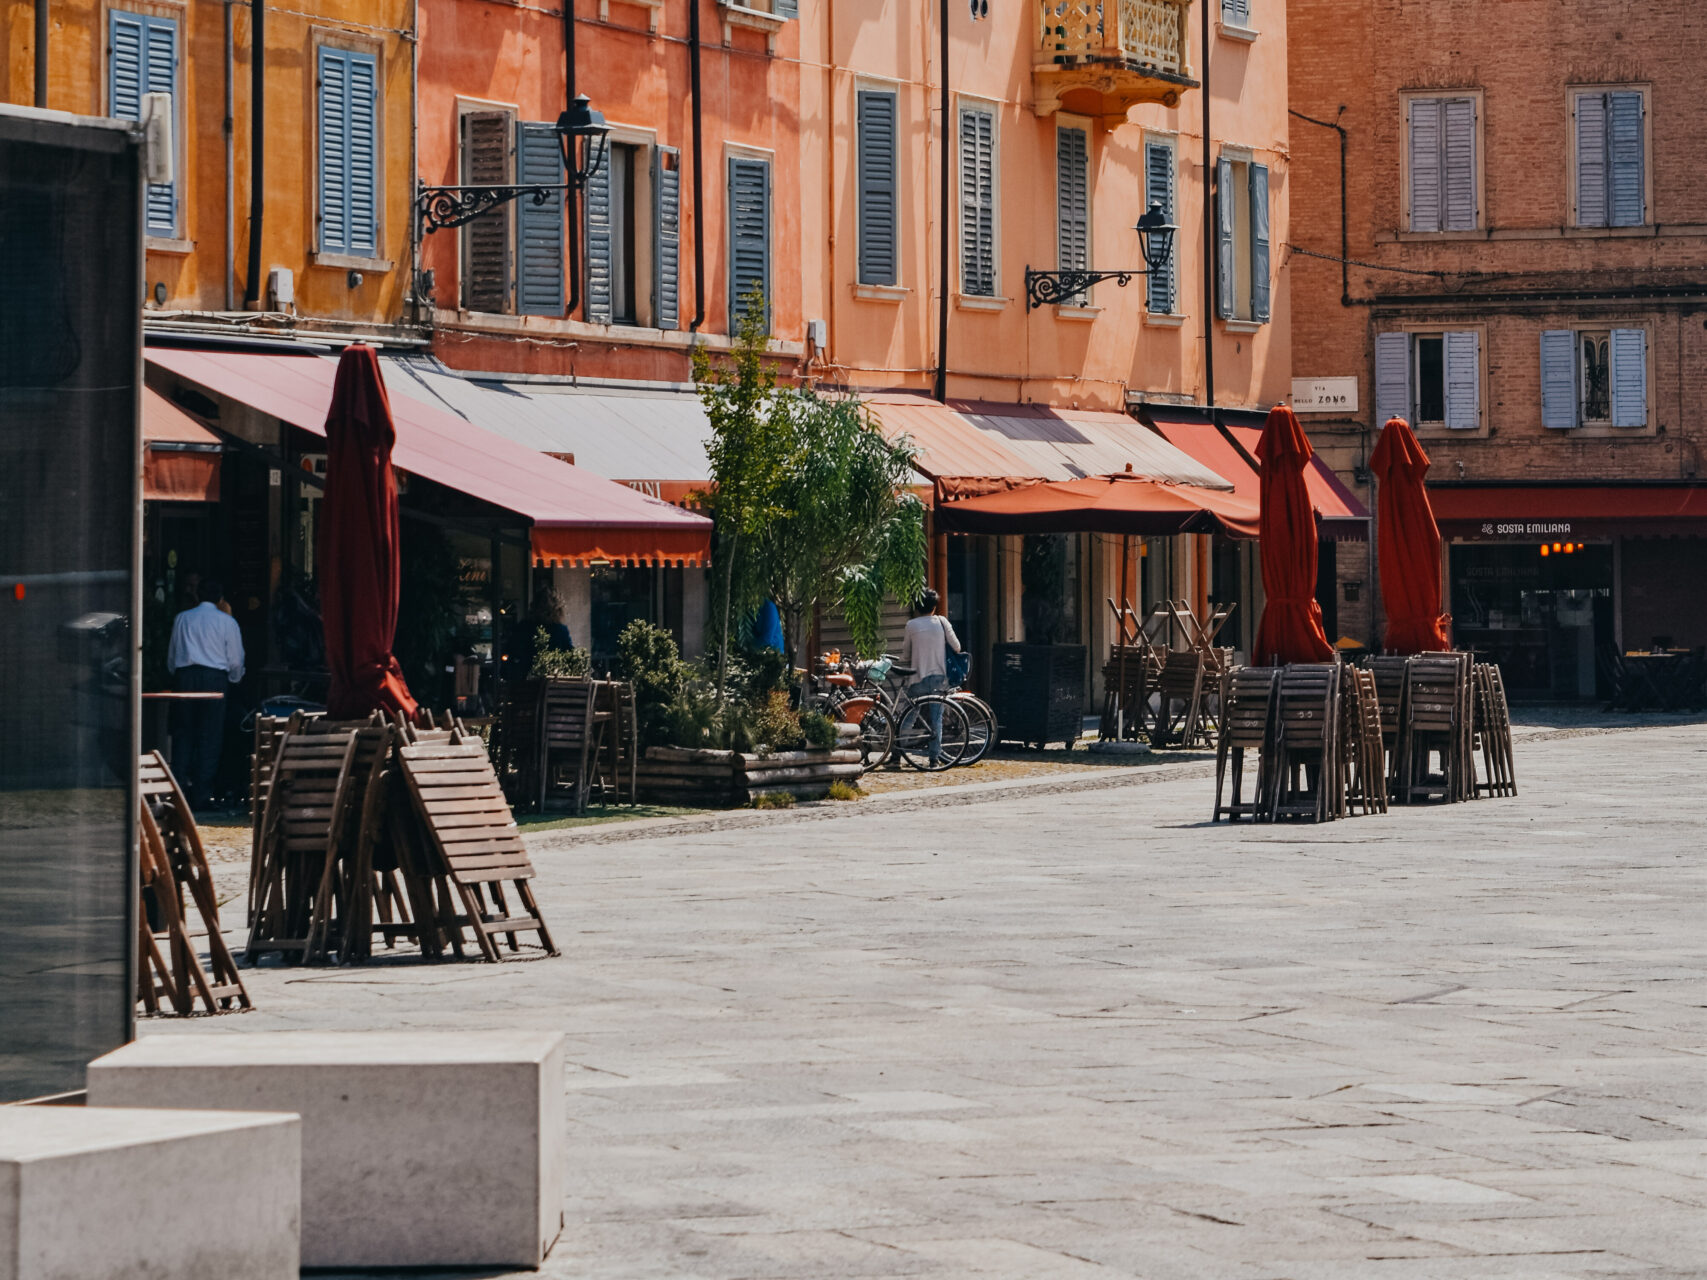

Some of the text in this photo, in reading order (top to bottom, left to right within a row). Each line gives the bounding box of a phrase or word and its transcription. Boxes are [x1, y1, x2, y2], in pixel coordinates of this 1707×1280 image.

[1318, 395, 1347, 405] ZONO
[1497, 523, 1571, 534] SOSTA EMILIANA
